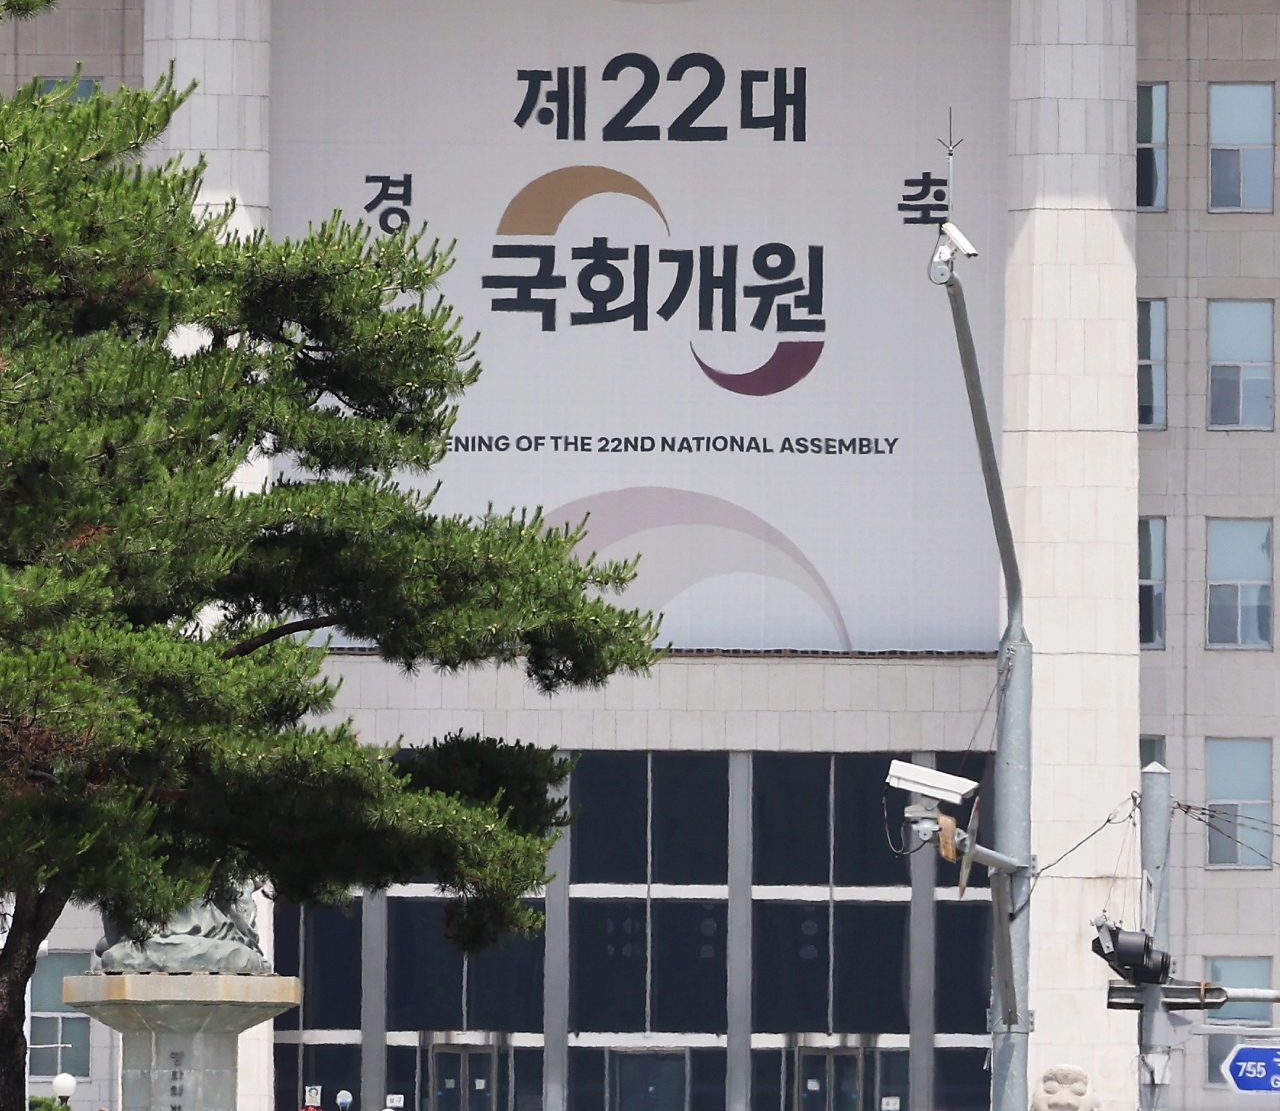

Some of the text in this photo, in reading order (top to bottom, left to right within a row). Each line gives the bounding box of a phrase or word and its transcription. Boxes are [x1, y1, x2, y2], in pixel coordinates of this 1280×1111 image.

[514, 52, 807, 142] 제22대
[364, 173, 412, 235] 경
[898, 171, 949, 228] 축
[481, 236, 826, 332] 국회개원
[516, 435, 546, 452] OF
[551, 435, 592, 452] THE
[598, 436, 656, 453] 22ND
[661, 436, 774, 454] NATIONAL
[781, 437, 899, 455] ASSEMBLY
[1237, 1061, 1267, 1079] 755
